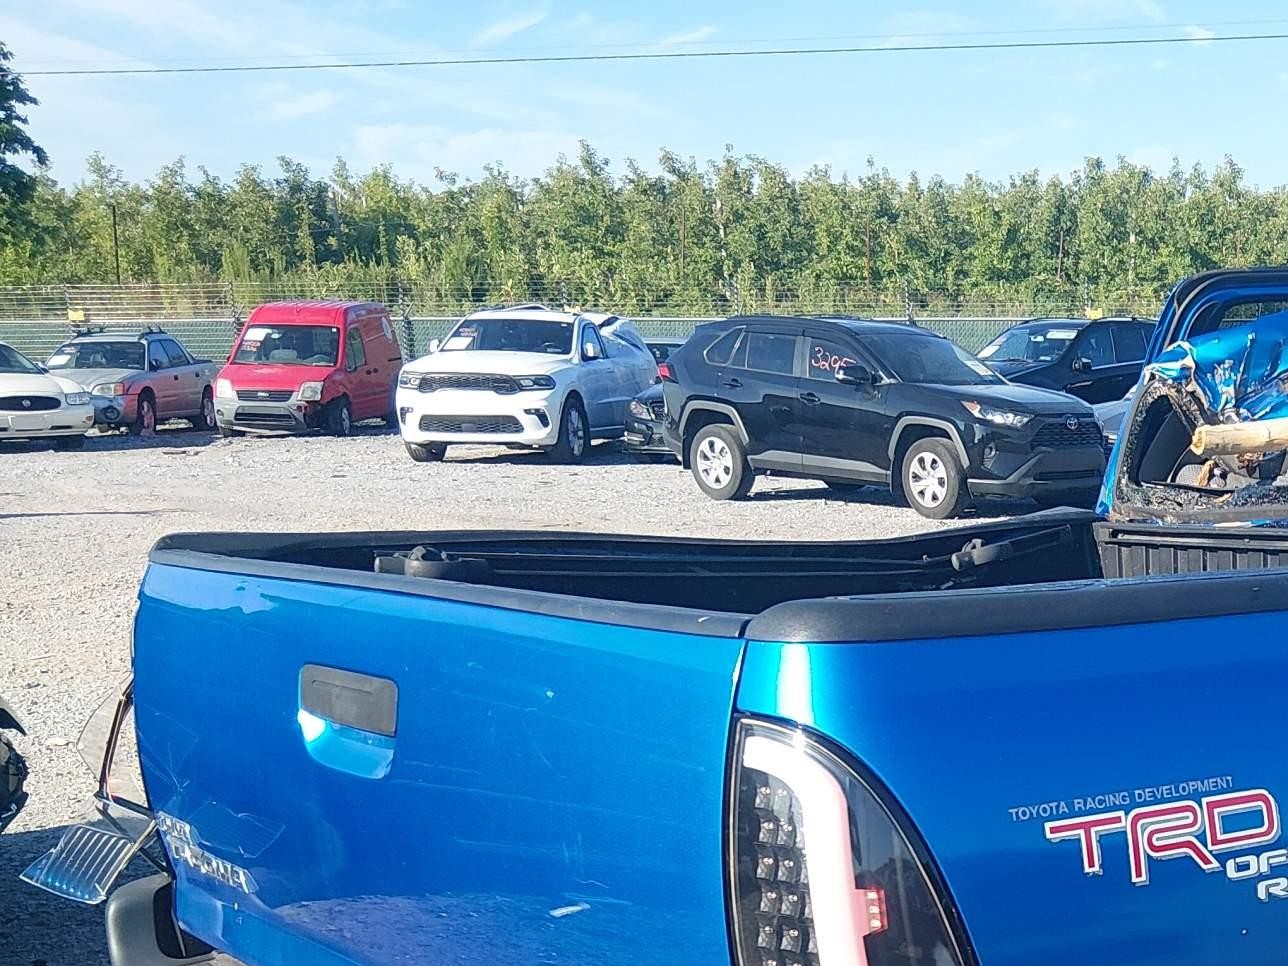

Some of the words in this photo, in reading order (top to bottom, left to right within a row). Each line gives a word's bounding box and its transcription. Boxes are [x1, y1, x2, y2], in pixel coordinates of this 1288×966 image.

[1008, 801, 1069, 822] TOYOTA
[1074, 791, 1130, 812] RACING
[1134, 775, 1234, 803] DEVELOPMENT
[1044, 788, 1282, 886] TRD
